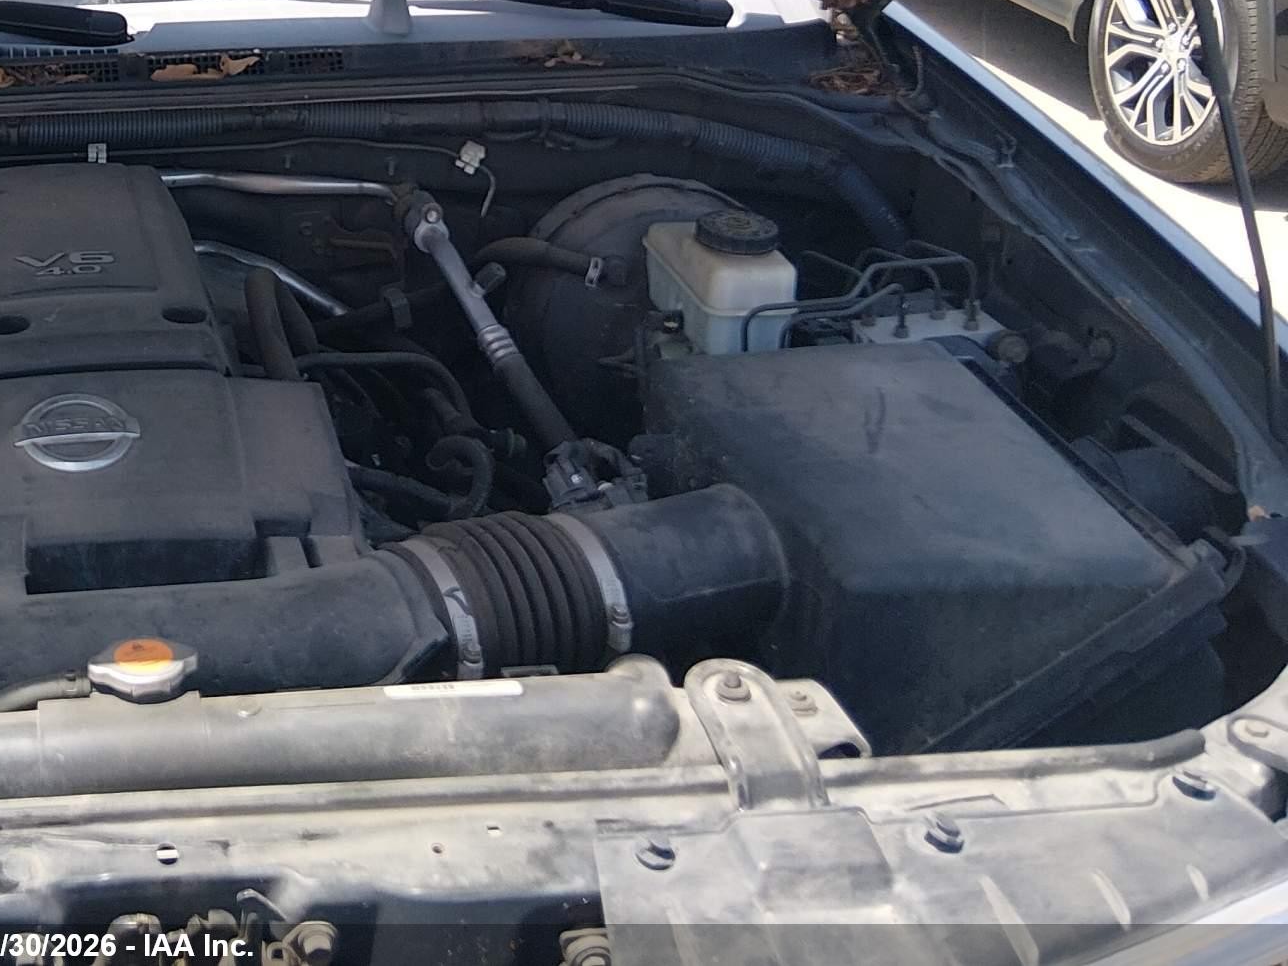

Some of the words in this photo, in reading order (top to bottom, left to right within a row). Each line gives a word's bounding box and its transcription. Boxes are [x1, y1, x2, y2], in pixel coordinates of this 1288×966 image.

[15, 250, 114, 268] V6
[36, 264, 101, 276] 4.0
[23, 414, 126, 438] NISSAN
